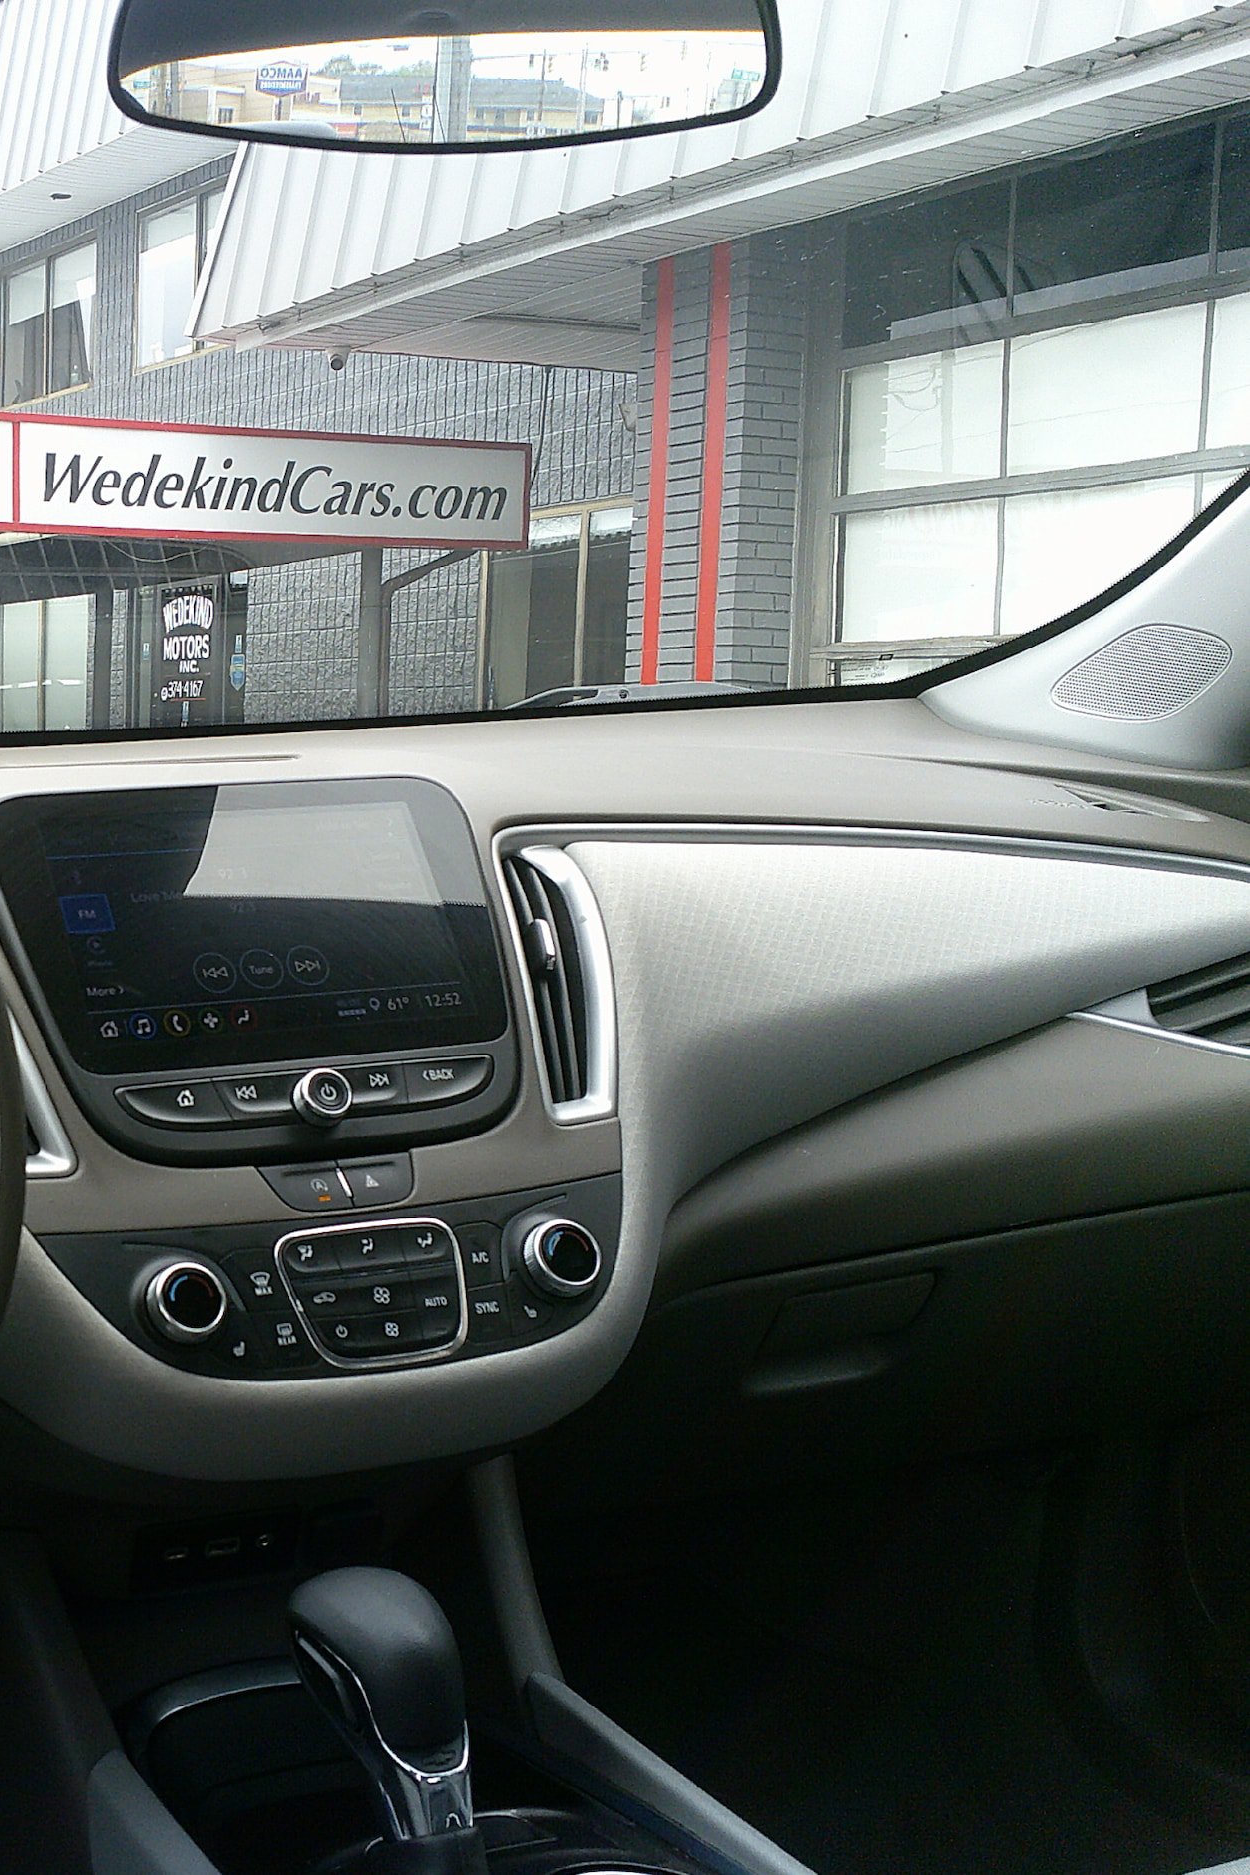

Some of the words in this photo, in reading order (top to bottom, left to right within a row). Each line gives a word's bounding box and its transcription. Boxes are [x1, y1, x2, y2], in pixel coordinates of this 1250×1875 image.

[43, 452, 508, 521] WedekindCars.com
[162, 594, 214, 634] WEDEKIND
[163, 634, 210, 661] MOTORS
[179, 660, 200, 673] INC.
[78, 909, 97, 919] FM
[86, 984, 116, 997] More
[425, 992, 462, 1007] 12:52
[471, 1251, 490, 1264] A/C
[424, 1296, 448, 1307] AUTO
[475, 1301, 500, 1315] SYNC
